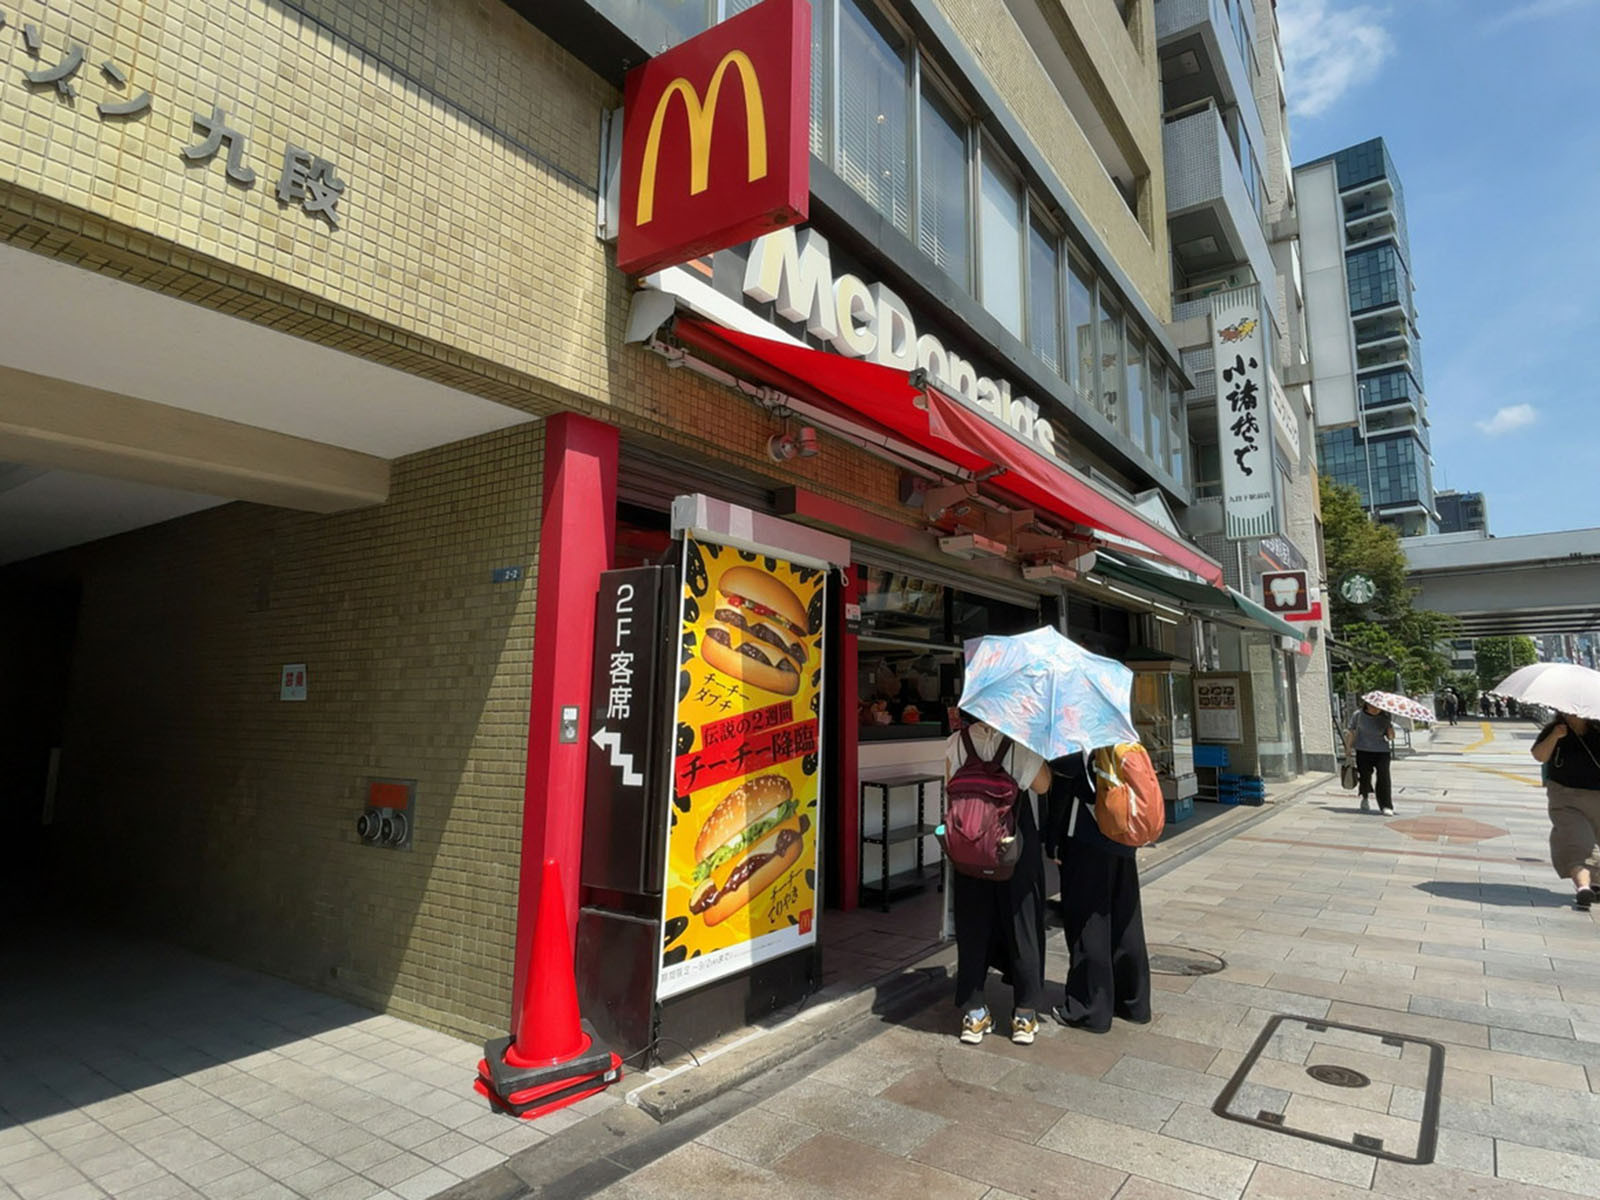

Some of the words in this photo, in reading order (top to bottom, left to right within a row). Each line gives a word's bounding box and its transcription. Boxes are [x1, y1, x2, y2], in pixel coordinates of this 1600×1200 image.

[743, 226, 1055, 456] McDonald's
[696, 687, 732, 712] ダブチ
[704, 673, 750, 700] チーチー
[704, 704, 792, 747] 伝説の2週間
[681, 725, 815, 789] チーチー降臨
